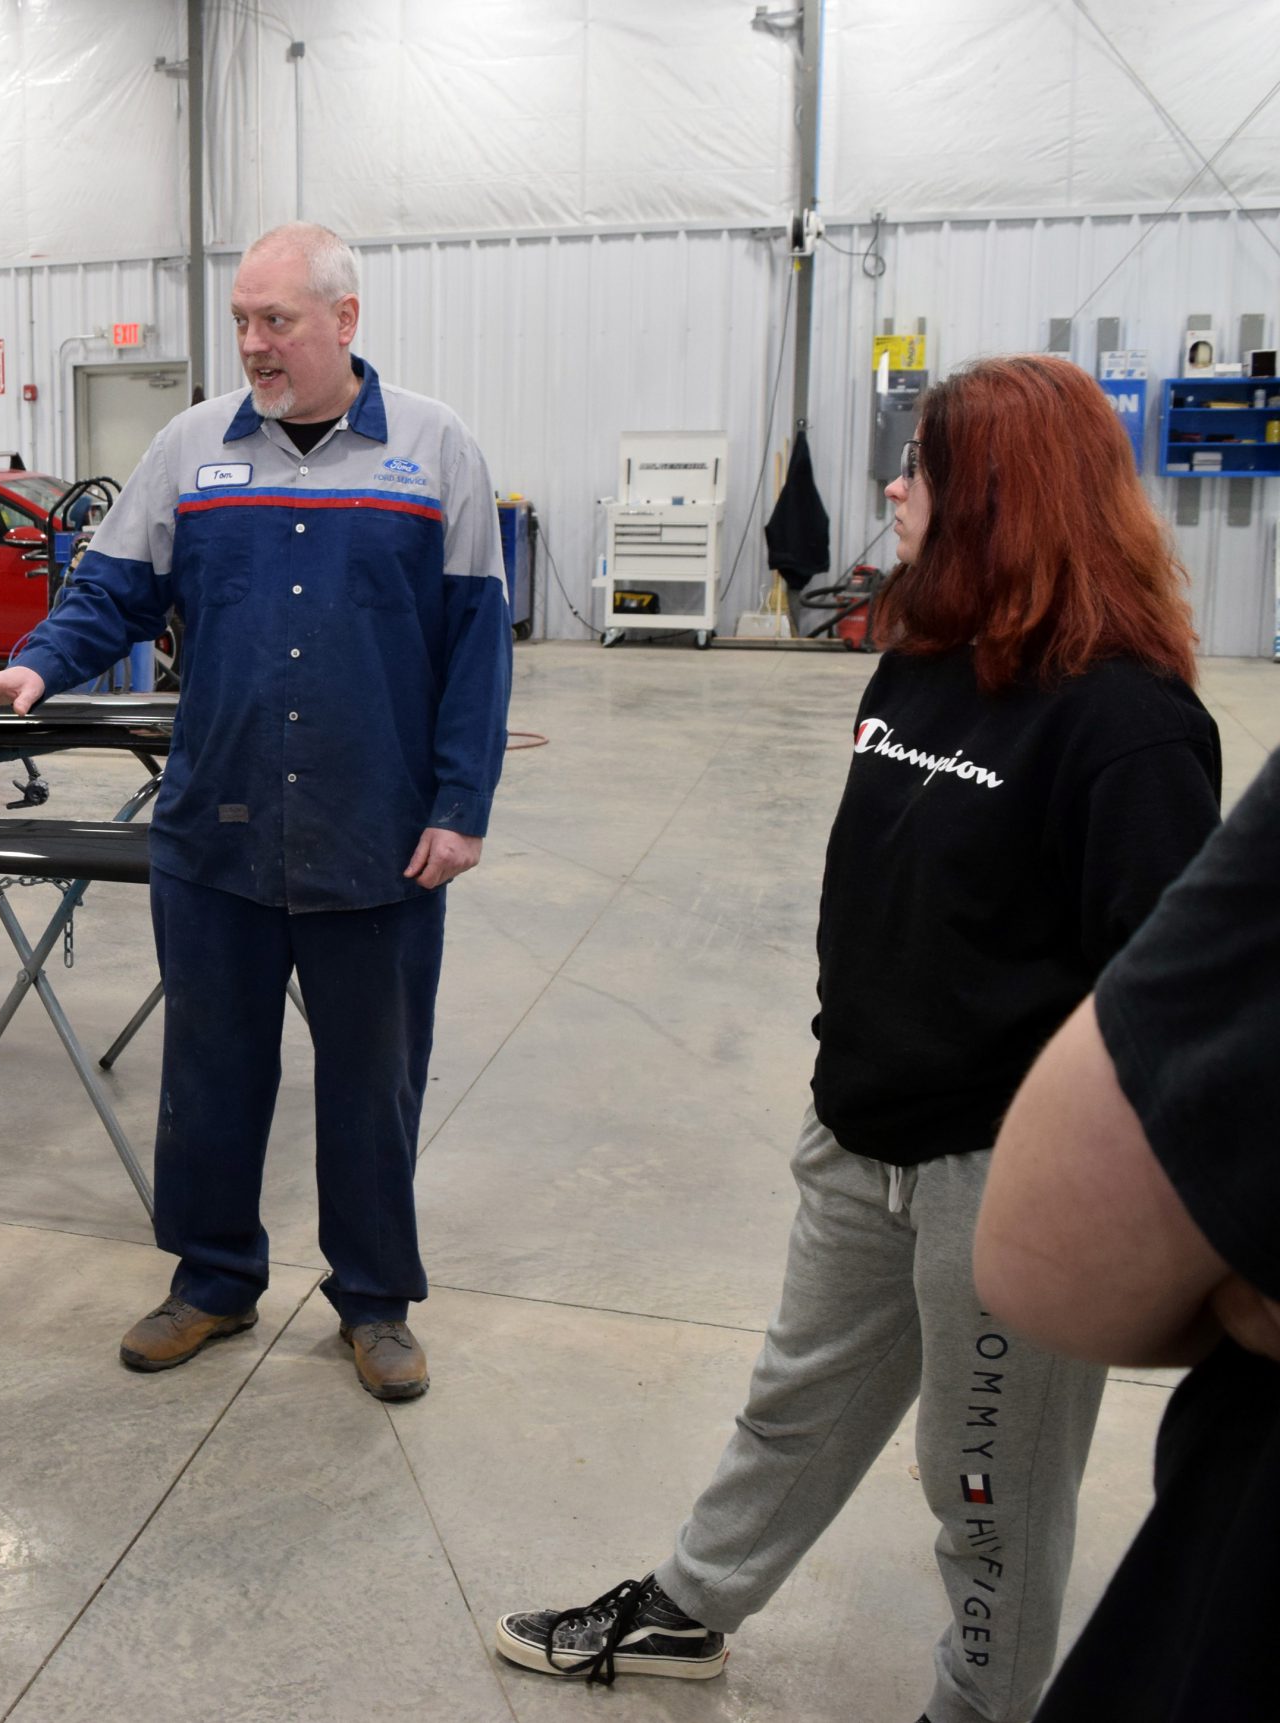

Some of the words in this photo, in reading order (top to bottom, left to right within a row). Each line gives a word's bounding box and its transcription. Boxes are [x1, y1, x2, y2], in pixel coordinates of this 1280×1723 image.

[113, 323, 140, 345] EXIT
[213, 469, 234, 481] Tom
[373, 473, 395, 482] FORD
[396, 475, 427, 486] SERVICE
[854, 717, 1003, 788] Champion
[962, 1310, 1008, 1460] OMMY
